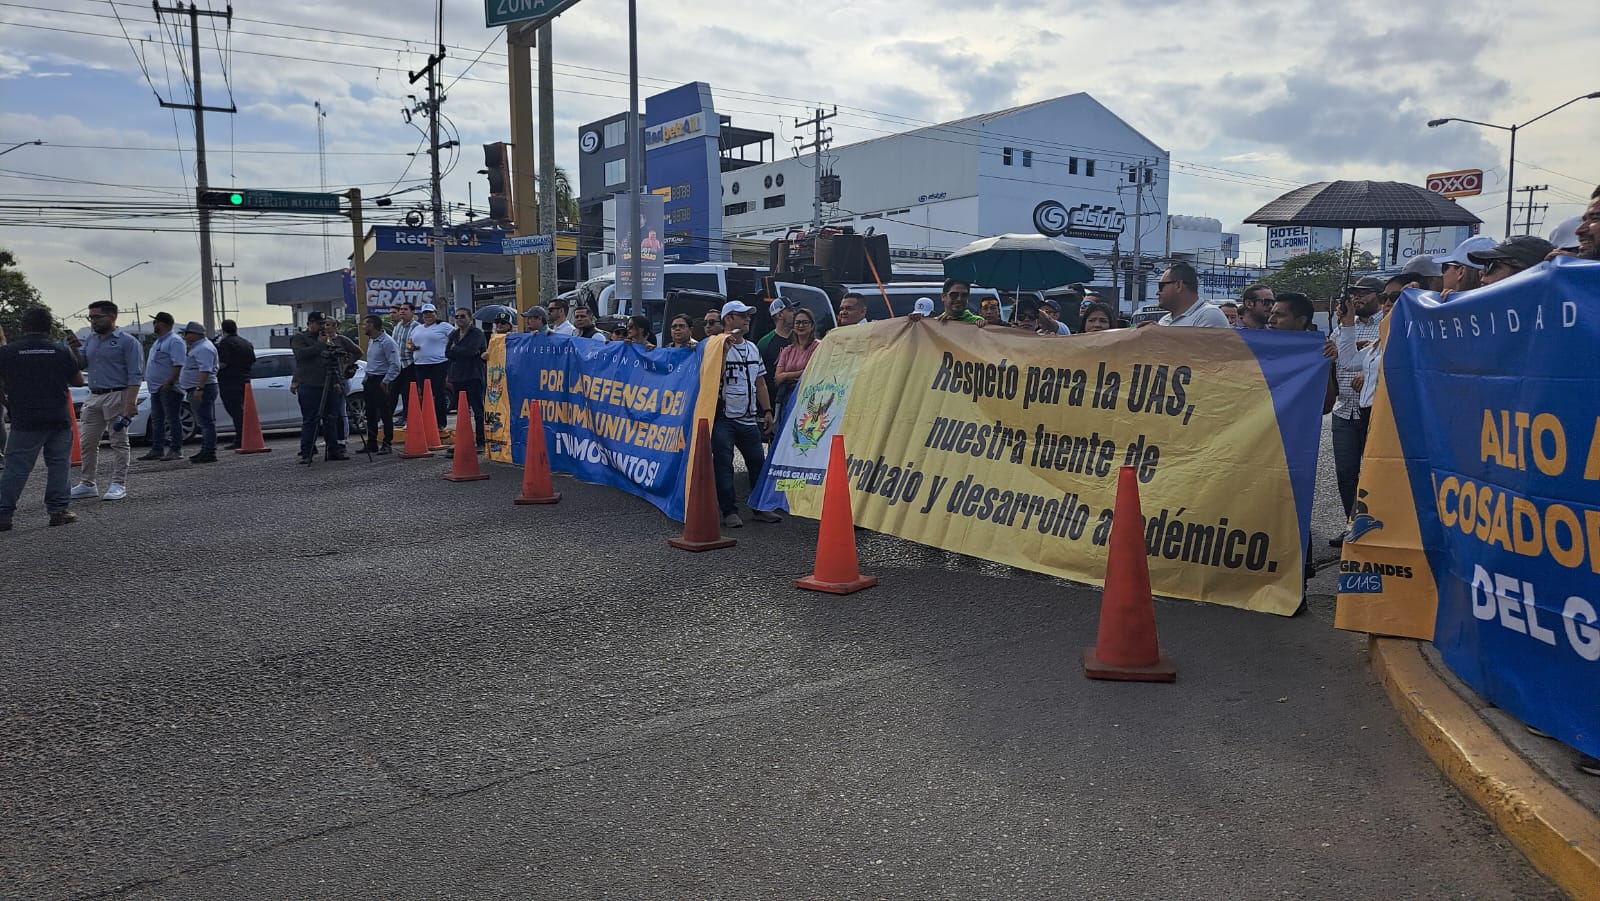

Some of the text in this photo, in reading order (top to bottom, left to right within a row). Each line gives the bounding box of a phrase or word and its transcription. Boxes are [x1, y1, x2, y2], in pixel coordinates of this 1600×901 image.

[1428, 174, 1478, 194] OXXO
[1270, 227, 1308, 239] HOTEL
[1270, 237, 1309, 249] CALIFORNIA
[1403, 246, 1447, 258] Calornia
[366, 289, 435, 307] GRATIS
[369, 279, 428, 291] GASOLINA
[1405, 301, 1577, 340] UNVERSIDAD
[540, 369, 564, 392] POR
[582, 375, 659, 413] DEFENSA
[931, 351, 1196, 426] Respeto para la UAS,
[519, 398, 595, 432] ATONOMÍA
[924, 416, 1160, 484] nuestra fuente de
[1480, 408, 1567, 477] ALTO
[605, 447, 660, 488] UNTOS!
[846, 453, 1279, 573] trabajo y desarrollo adémico.
[1431, 471, 1600, 574] COSADO
[1340, 559, 1413, 579] GRANDES
[1346, 575, 1381, 591] UAS
[1471, 563, 1557, 646] DEL
